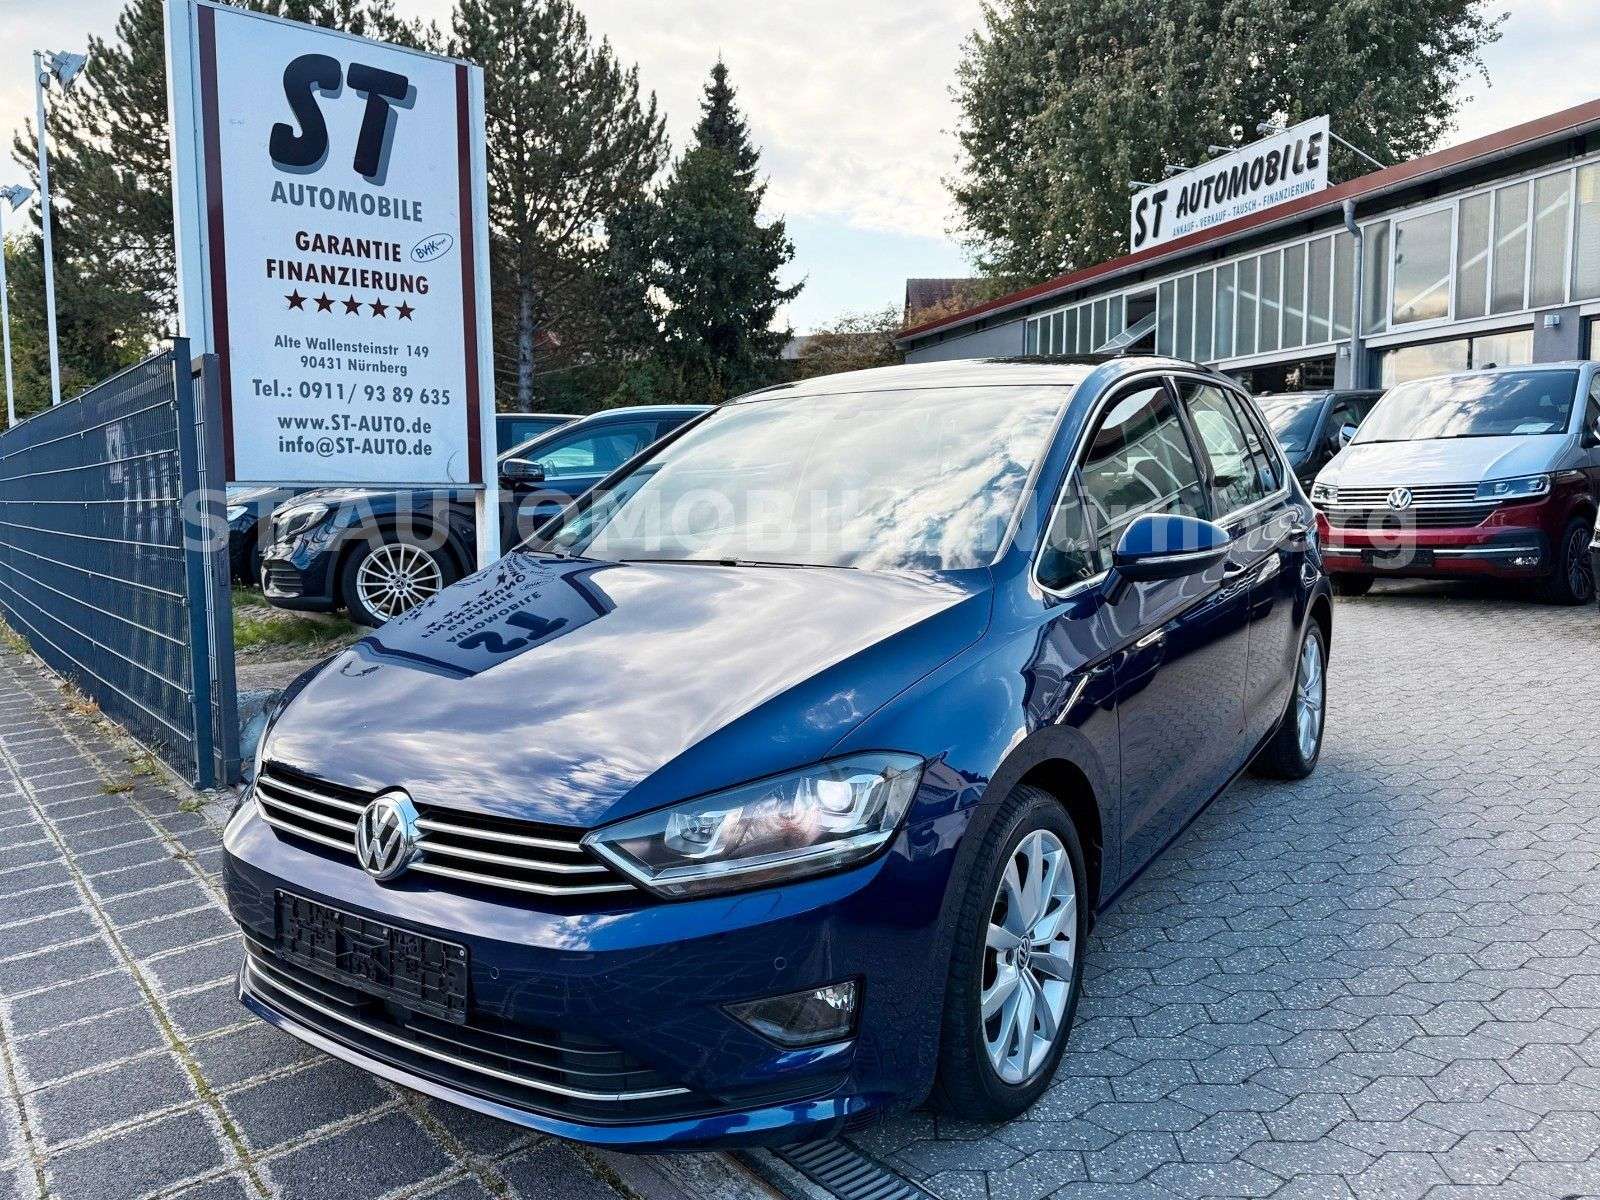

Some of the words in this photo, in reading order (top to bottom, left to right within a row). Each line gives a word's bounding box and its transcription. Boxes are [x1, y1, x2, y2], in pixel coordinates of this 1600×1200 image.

[269, 53, 417, 186] ST
[270, 180, 423, 223] AUTOMOBILE
[1134, 189, 1168, 248] ST
[1176, 131, 1324, 219] AUTOMOBILE
[1173, 221, 1194, 236] ANKAUF
[1200, 210, 1227, 228] VERKAUF
[1233, 199, 1257, 216] TAUSCH
[1263, 178, 1316, 205] FINANZIERUNG
[295, 230, 401, 262] GARANTIE
[266, 258, 430, 295] FINANZIERUNG
[274, 335, 300, 349] Alte
[406, 345, 430, 358] 149
[300, 356, 342, 371] 90431
[348, 358, 408, 377] Nürnberg
[252, 379, 292, 397] Tel.:
[364, 384, 386, 402] 93
[392, 386, 413, 403] 89
[419, 388, 450, 406] 635
[277, 414, 432, 434] www.ST-AUTO.de
[279, 435, 433, 458] info@ST-AUTO.de
